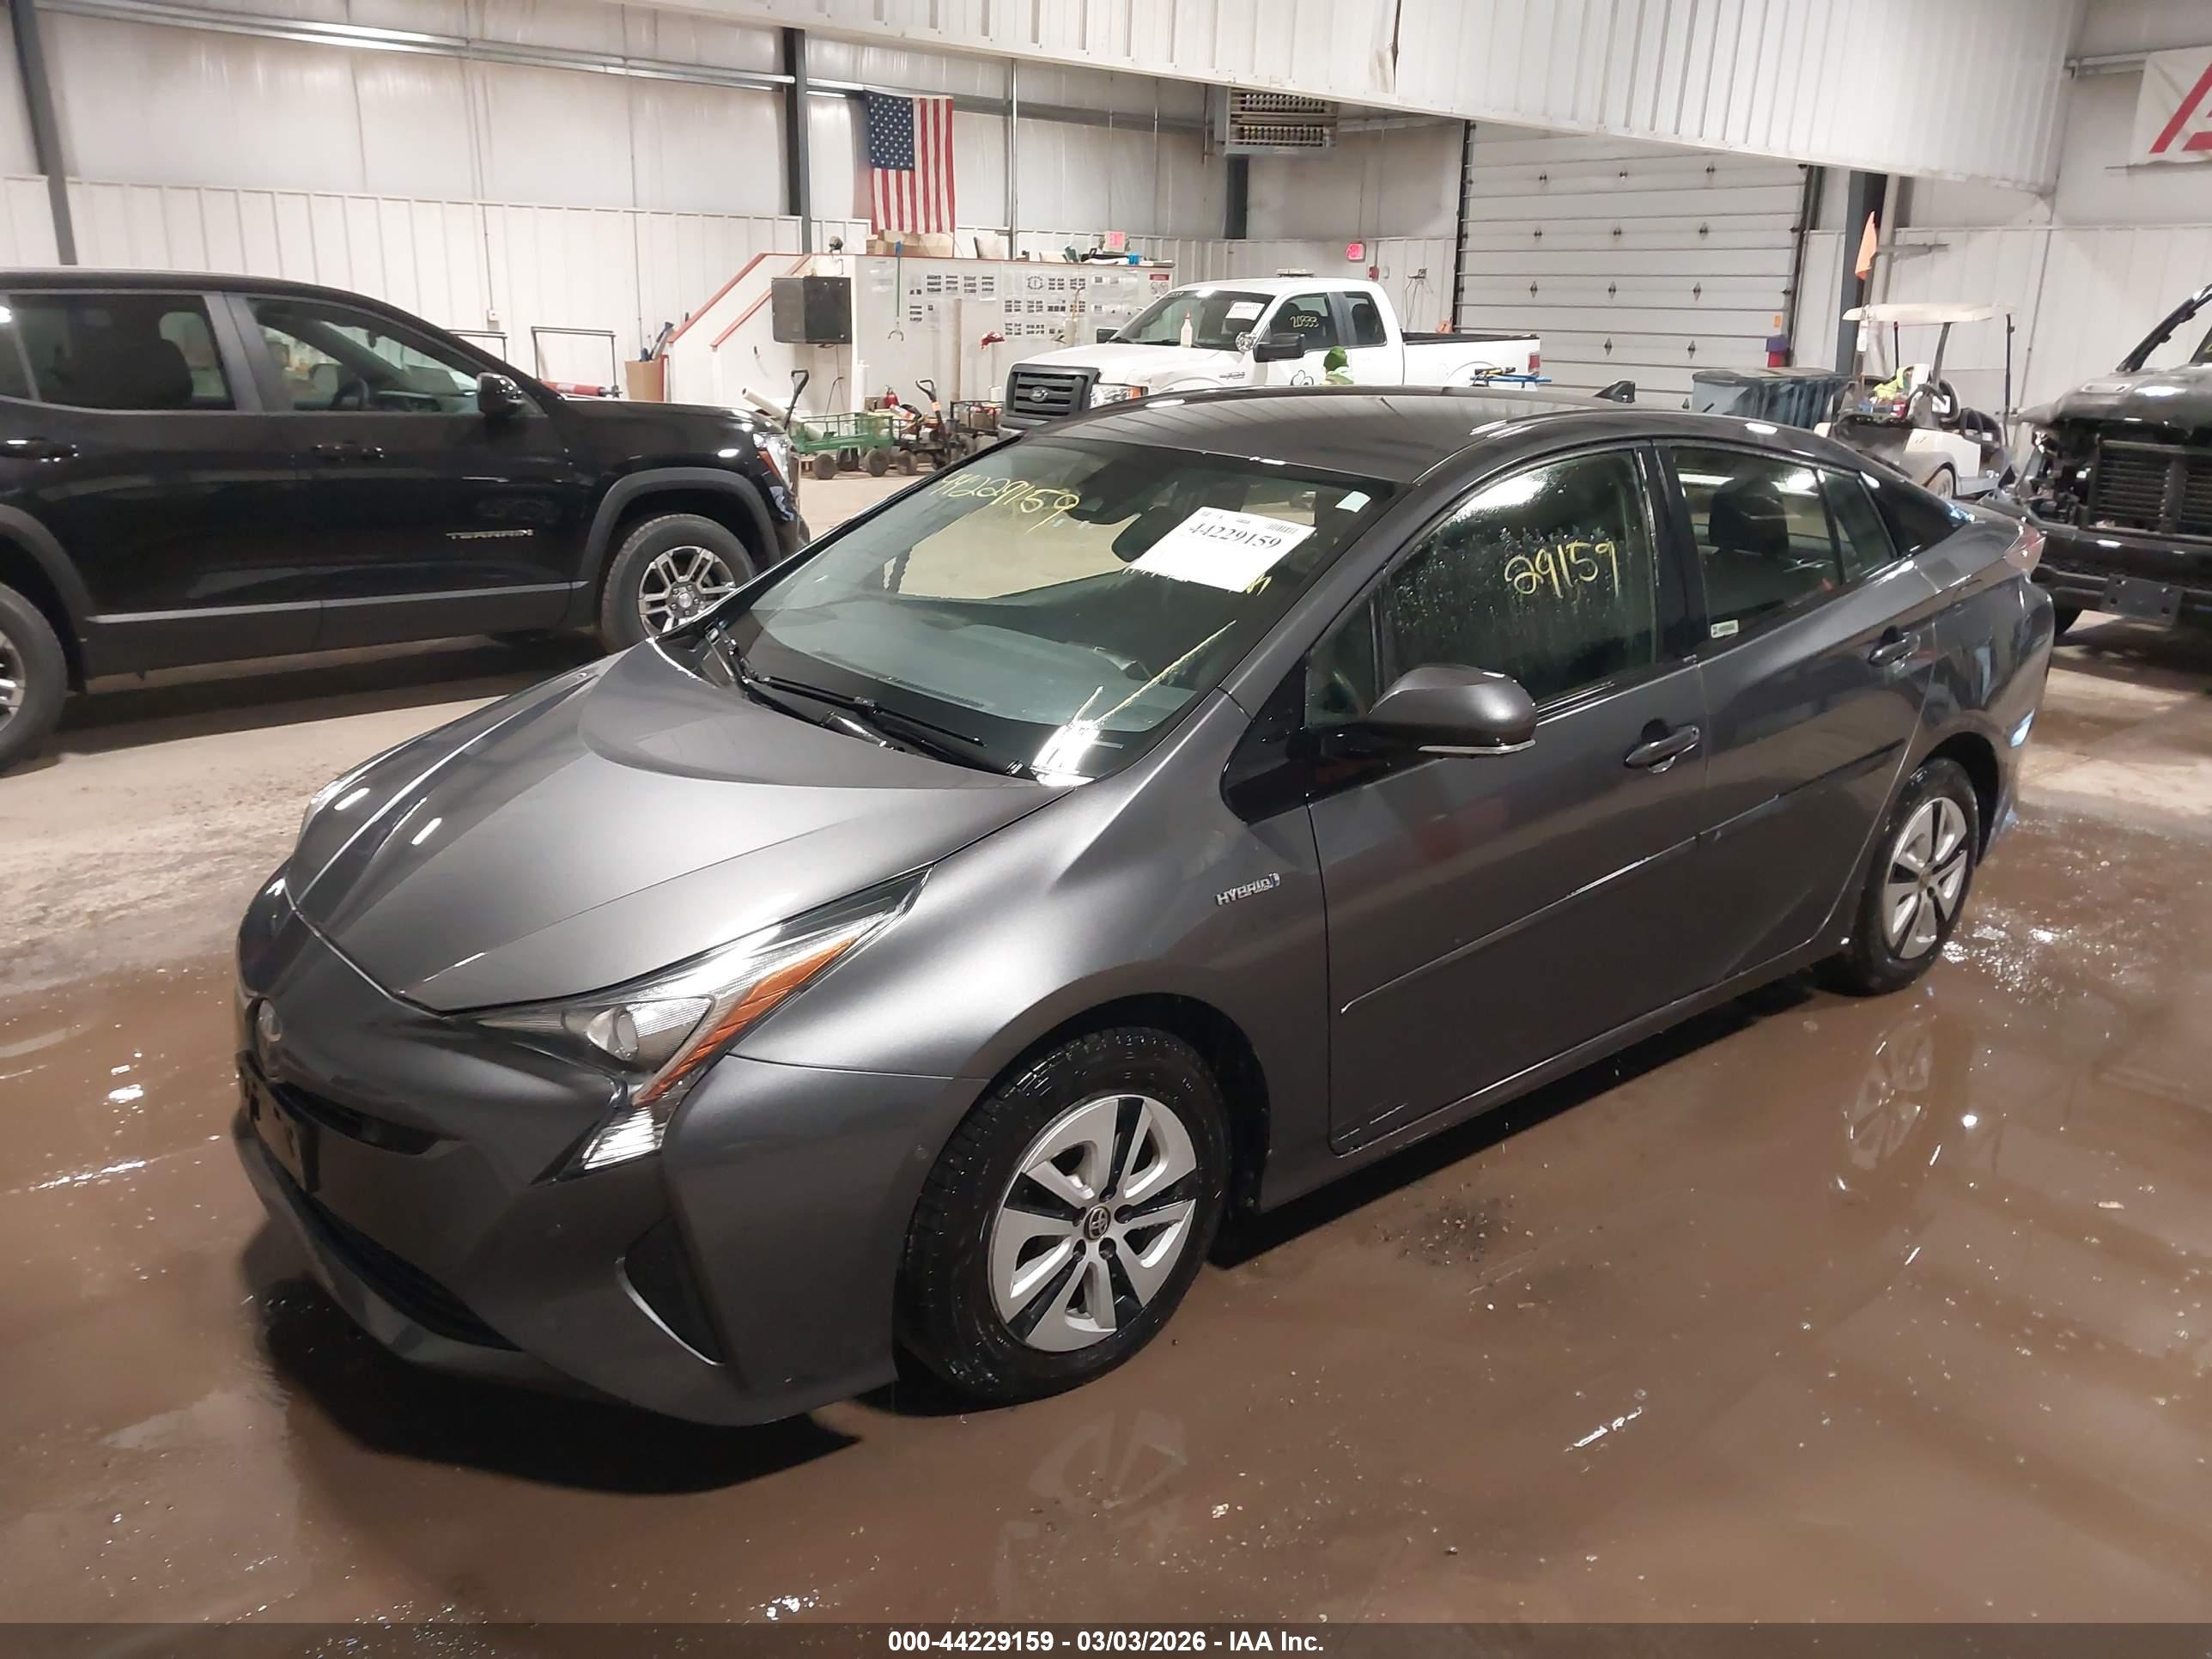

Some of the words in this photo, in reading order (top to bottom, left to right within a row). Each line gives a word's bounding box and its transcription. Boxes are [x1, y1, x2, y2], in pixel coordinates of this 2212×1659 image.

[929, 469, 1080, 535] 44229159
[1188, 522, 1283, 550] 44229159
[1503, 540, 1621, 599] 29159
[1216, 876, 1274, 906] HYBRID
